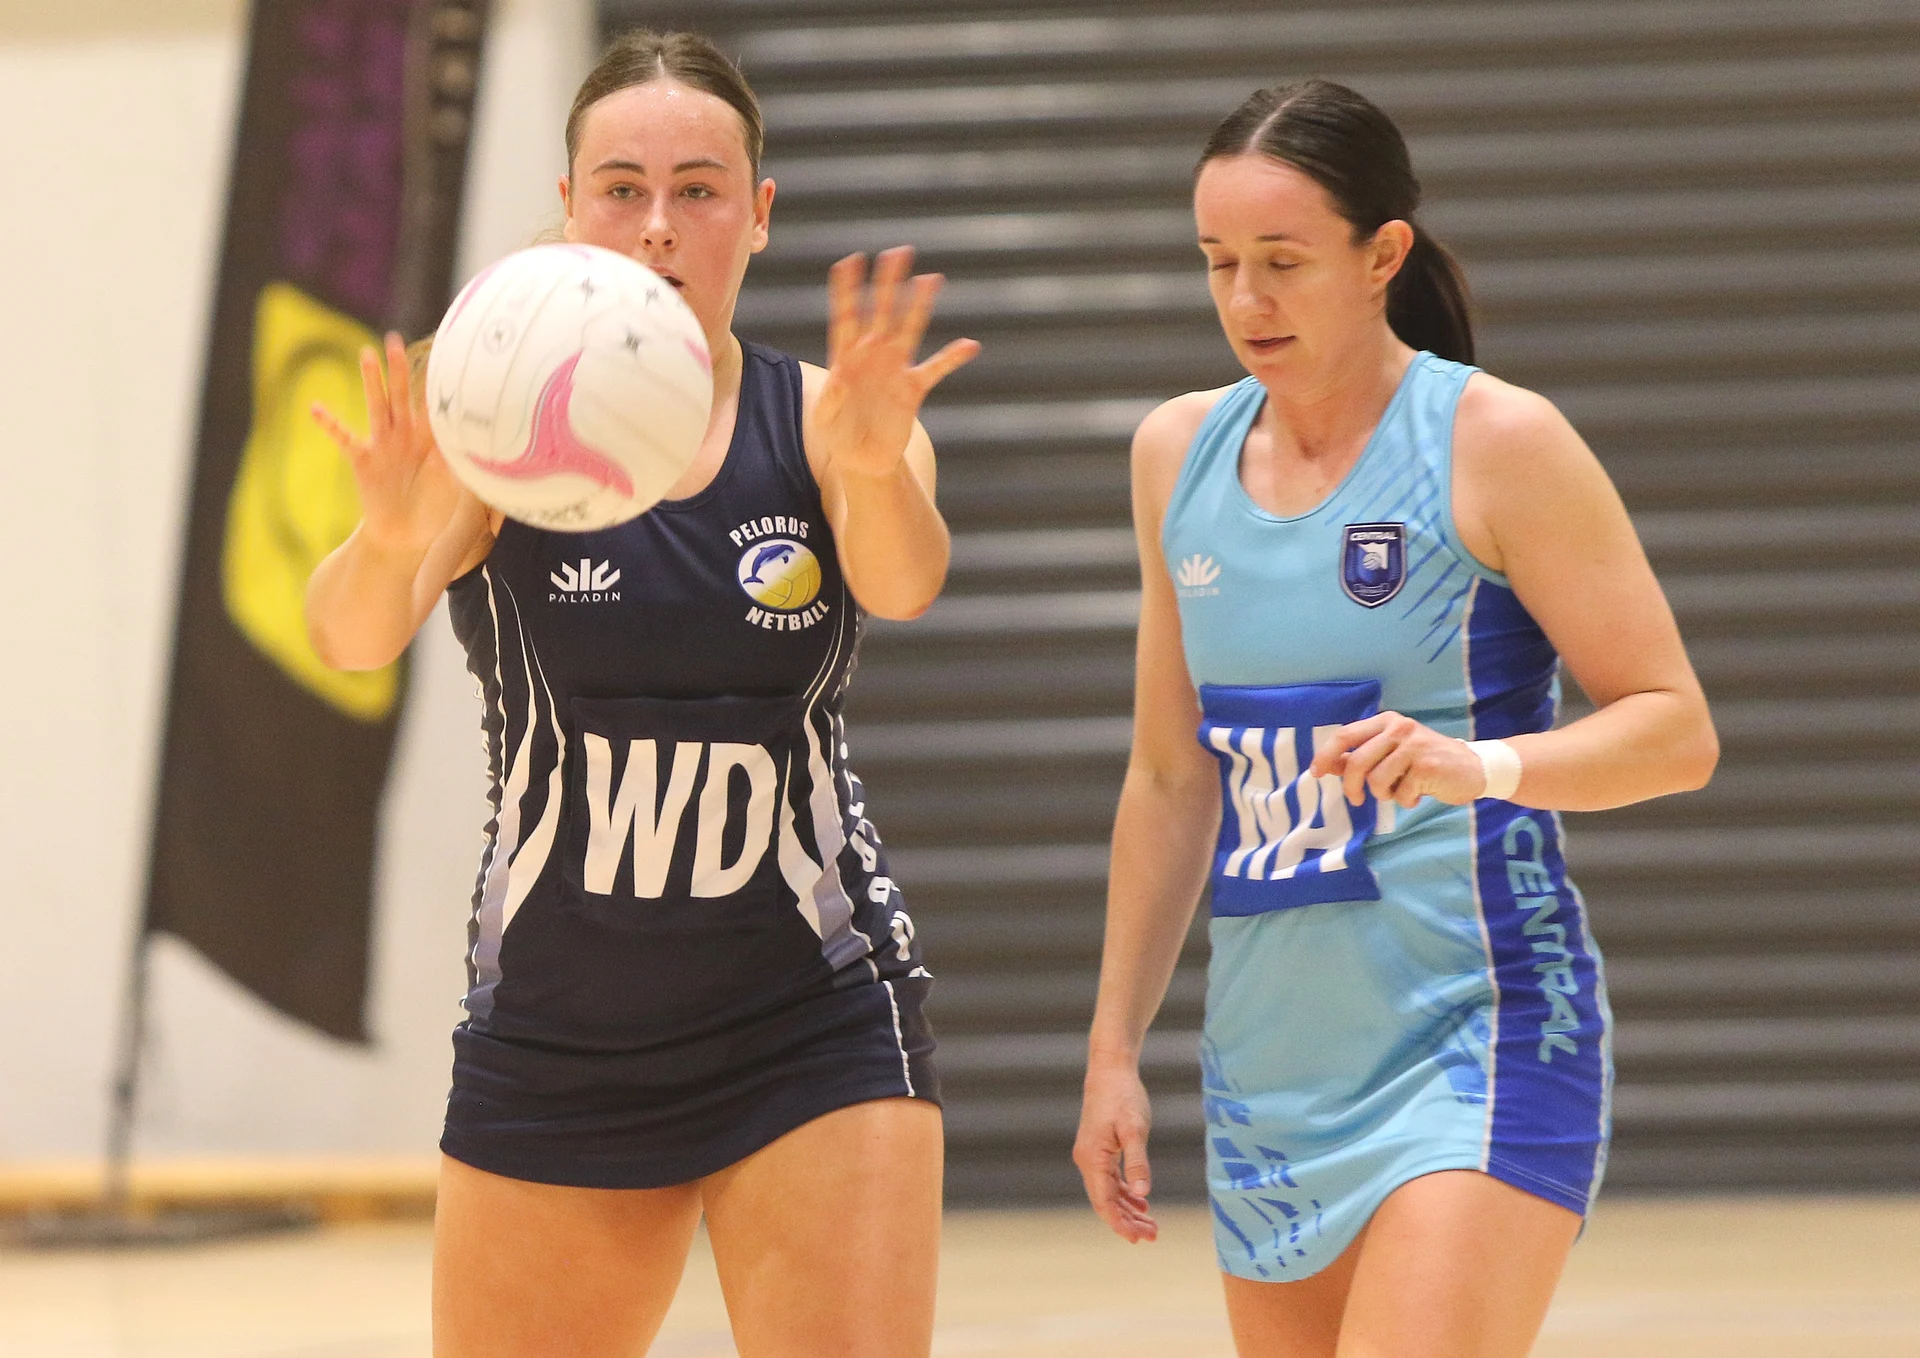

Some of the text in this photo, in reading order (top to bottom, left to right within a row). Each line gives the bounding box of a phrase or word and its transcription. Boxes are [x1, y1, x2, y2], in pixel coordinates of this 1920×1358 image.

[729, 514, 809, 547] PELORUS
[549, 592, 621, 603] PALADIN
[745, 600, 830, 632] NETBALL
[583, 732, 777, 899] WD
[1503, 815, 1580, 1064] CENTRAL
